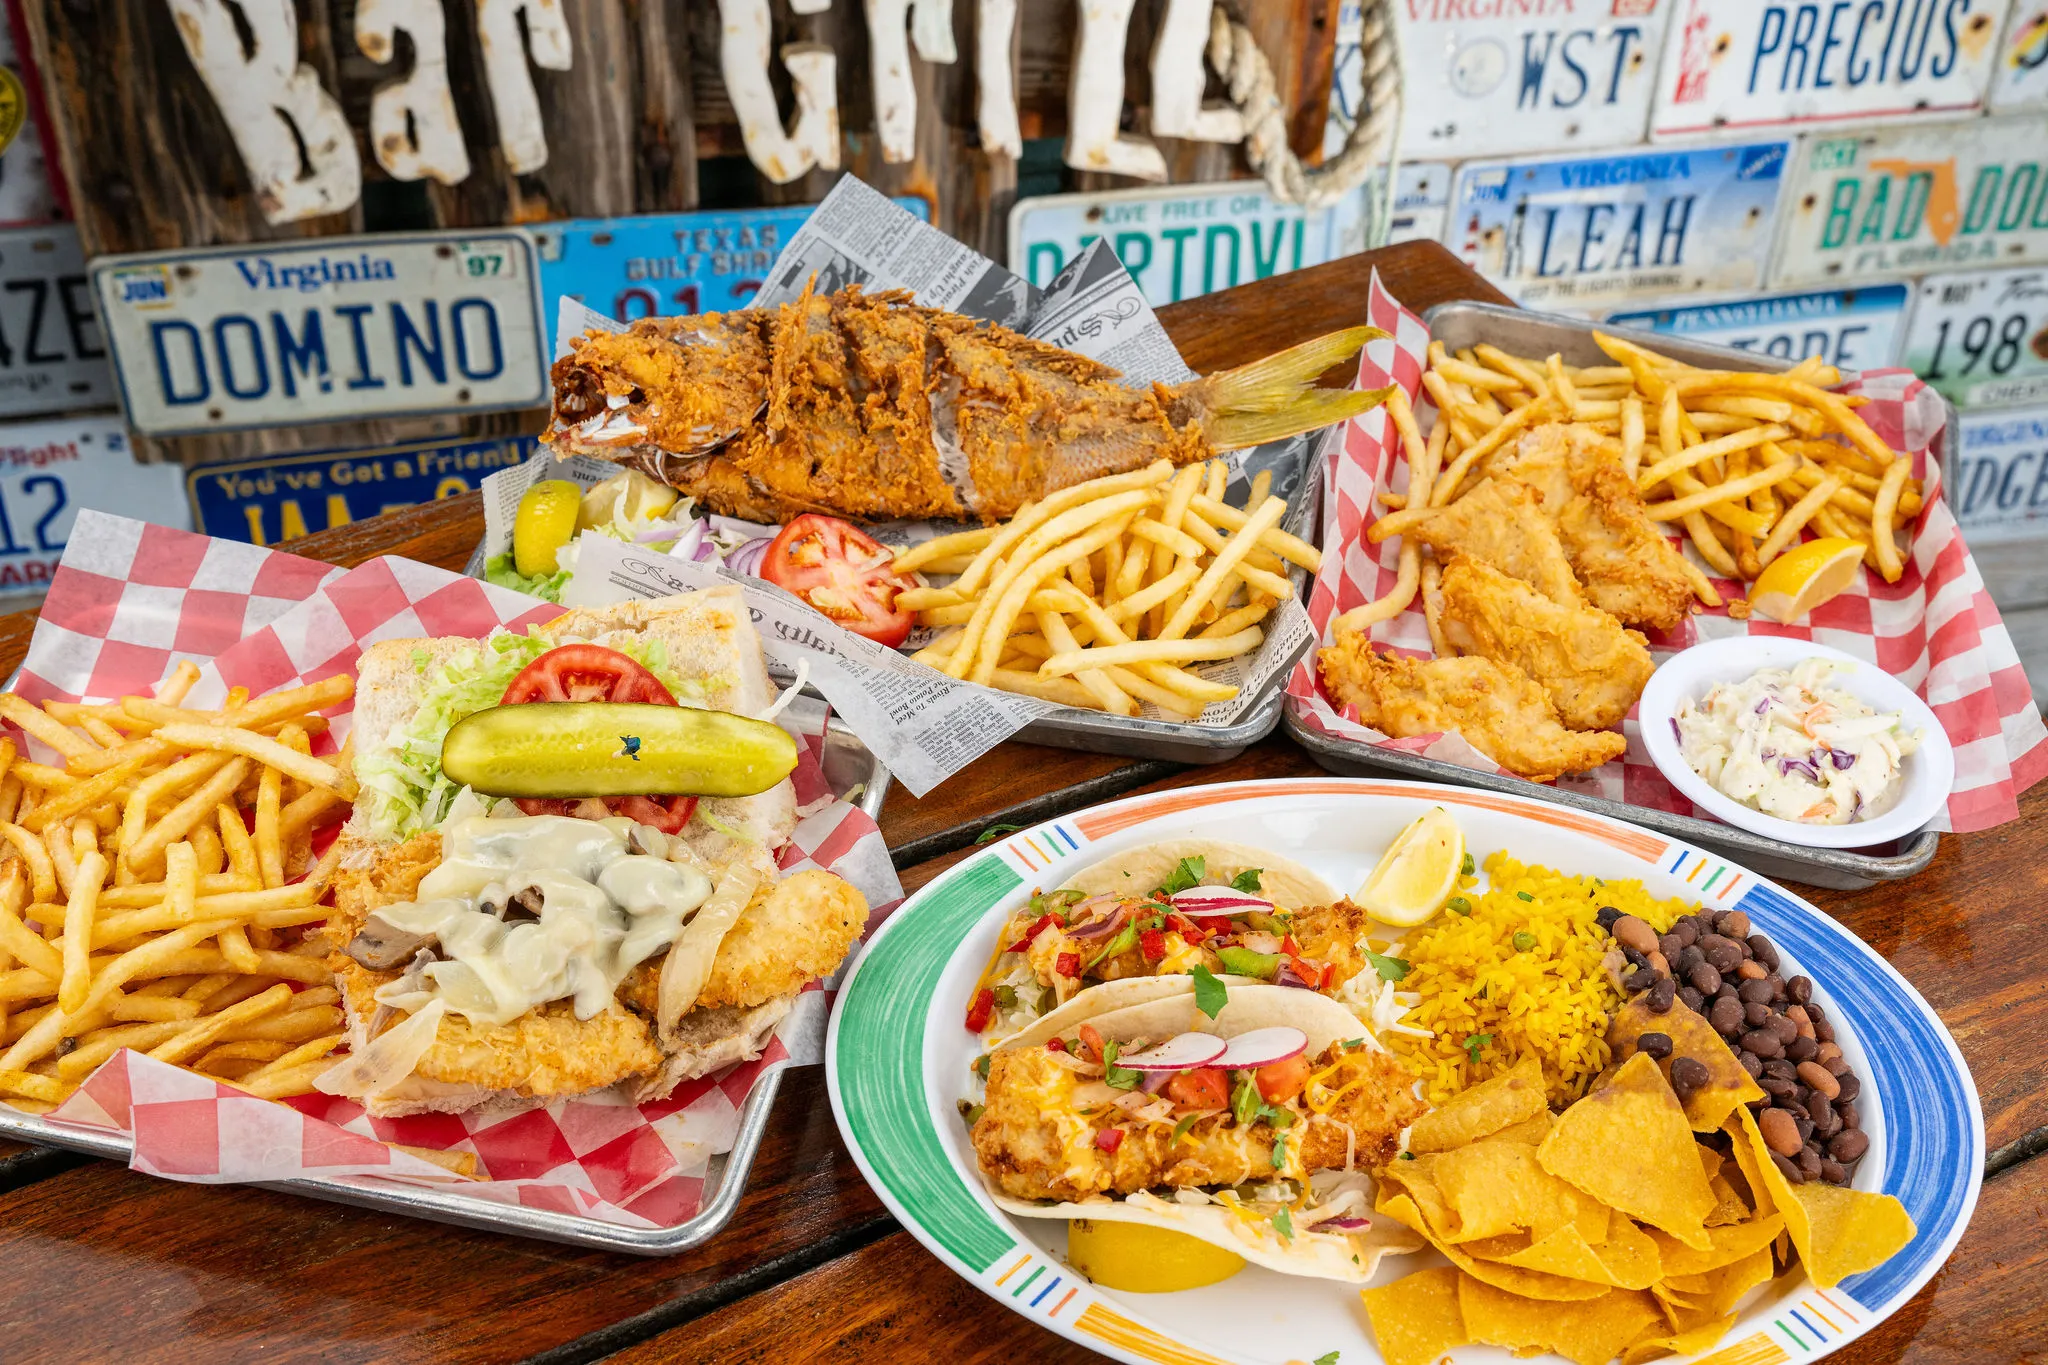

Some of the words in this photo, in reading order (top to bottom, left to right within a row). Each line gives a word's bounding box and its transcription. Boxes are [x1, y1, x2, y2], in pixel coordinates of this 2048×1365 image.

[1746, 0, 1970, 94] PRECIUS
[1516, 26, 1641, 110] WST
[1559, 154, 1691, 187] VIRGINIA
[1103, 202, 1147, 225] LIVE
[1160, 198, 1217, 220] FREE
[1229, 195, 1261, 214] OR
[1817, 171, 1933, 251] BAD
[673, 224, 779, 253] TEXAS
[1534, 193, 1698, 278] LEAH
[467, 255, 504, 276] 97
[711, 248, 778, 277] SHR
[1854, 240, 1998, 271] FLORIDA
[234, 253, 396, 293] Virginia
[930, 285, 945, 300] Up
[0, 275, 107, 369] ZE
[150, 295, 506, 407] DOMINO
[1918, 312, 2028, 382] 198
[216, 461, 322, 500] You've
[329, 459, 387, 486] Got
[393, 459, 414, 479] a
[416, 441, 522, 477] Friend
[909, 686, 933, 704] Potato
[916, 703, 927, 711] To
[926, 686, 950, 703] Rivals
[889, 702, 909, 719] Bowl
[896, 709, 916, 726] Meet
